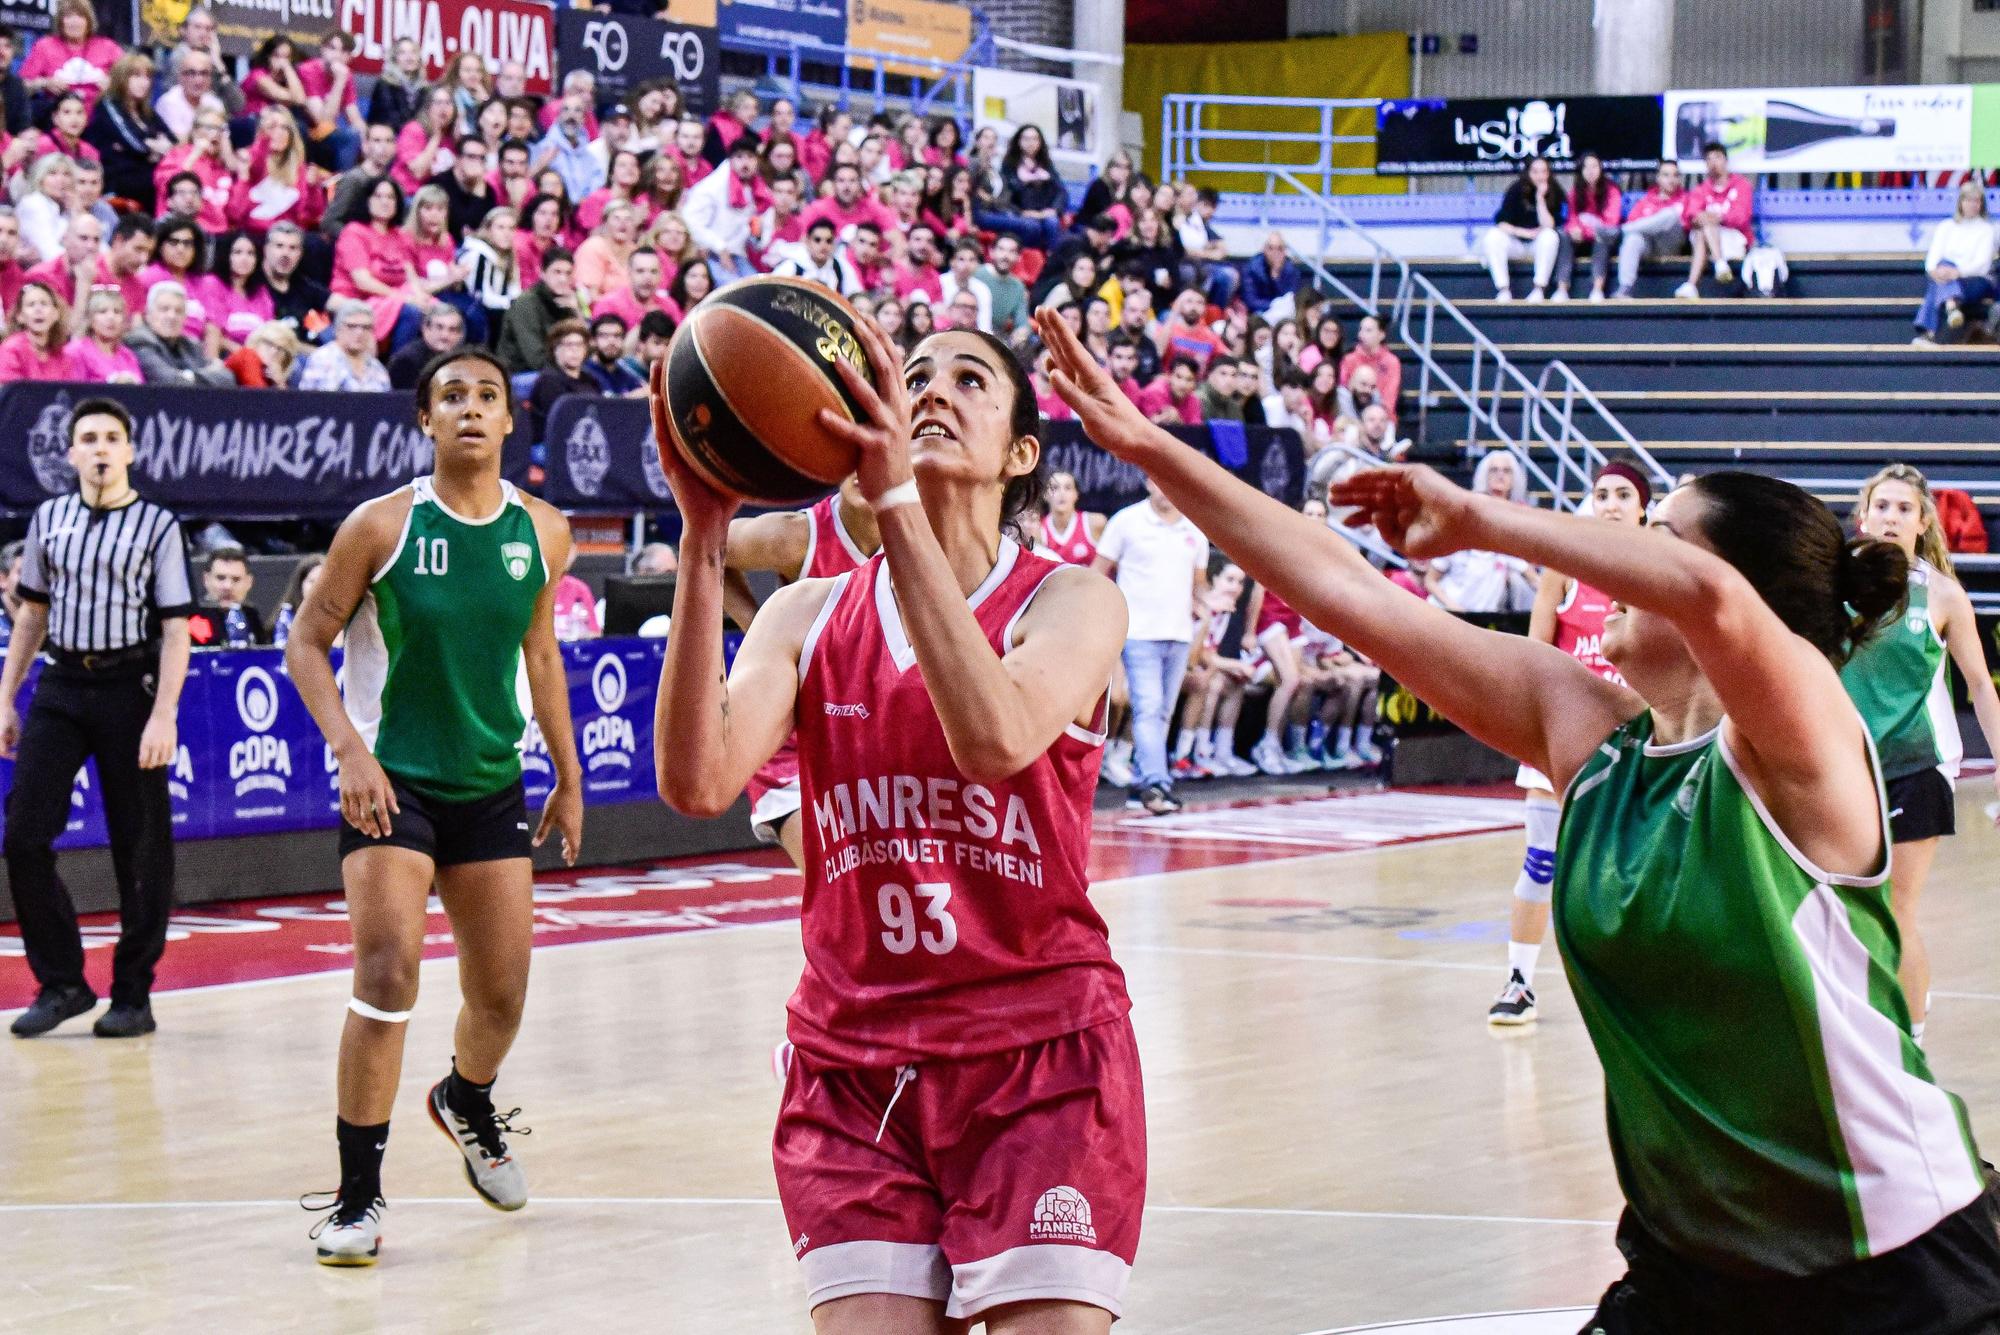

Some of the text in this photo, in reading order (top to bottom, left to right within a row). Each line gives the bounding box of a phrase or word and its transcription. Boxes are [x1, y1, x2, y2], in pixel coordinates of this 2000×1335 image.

[583, 20, 629, 71] 50
[660, 31, 705, 80] 50
[413, 536, 449, 575] 10
[229, 735, 292, 780] COPA
[583, 715, 635, 756] COPA
[813, 775, 1041, 853] MANRESA
[955, 841, 1044, 889] FEMENÍ
[877, 882, 958, 955] 93
[1029, 1221, 1097, 1240] MANRESA
